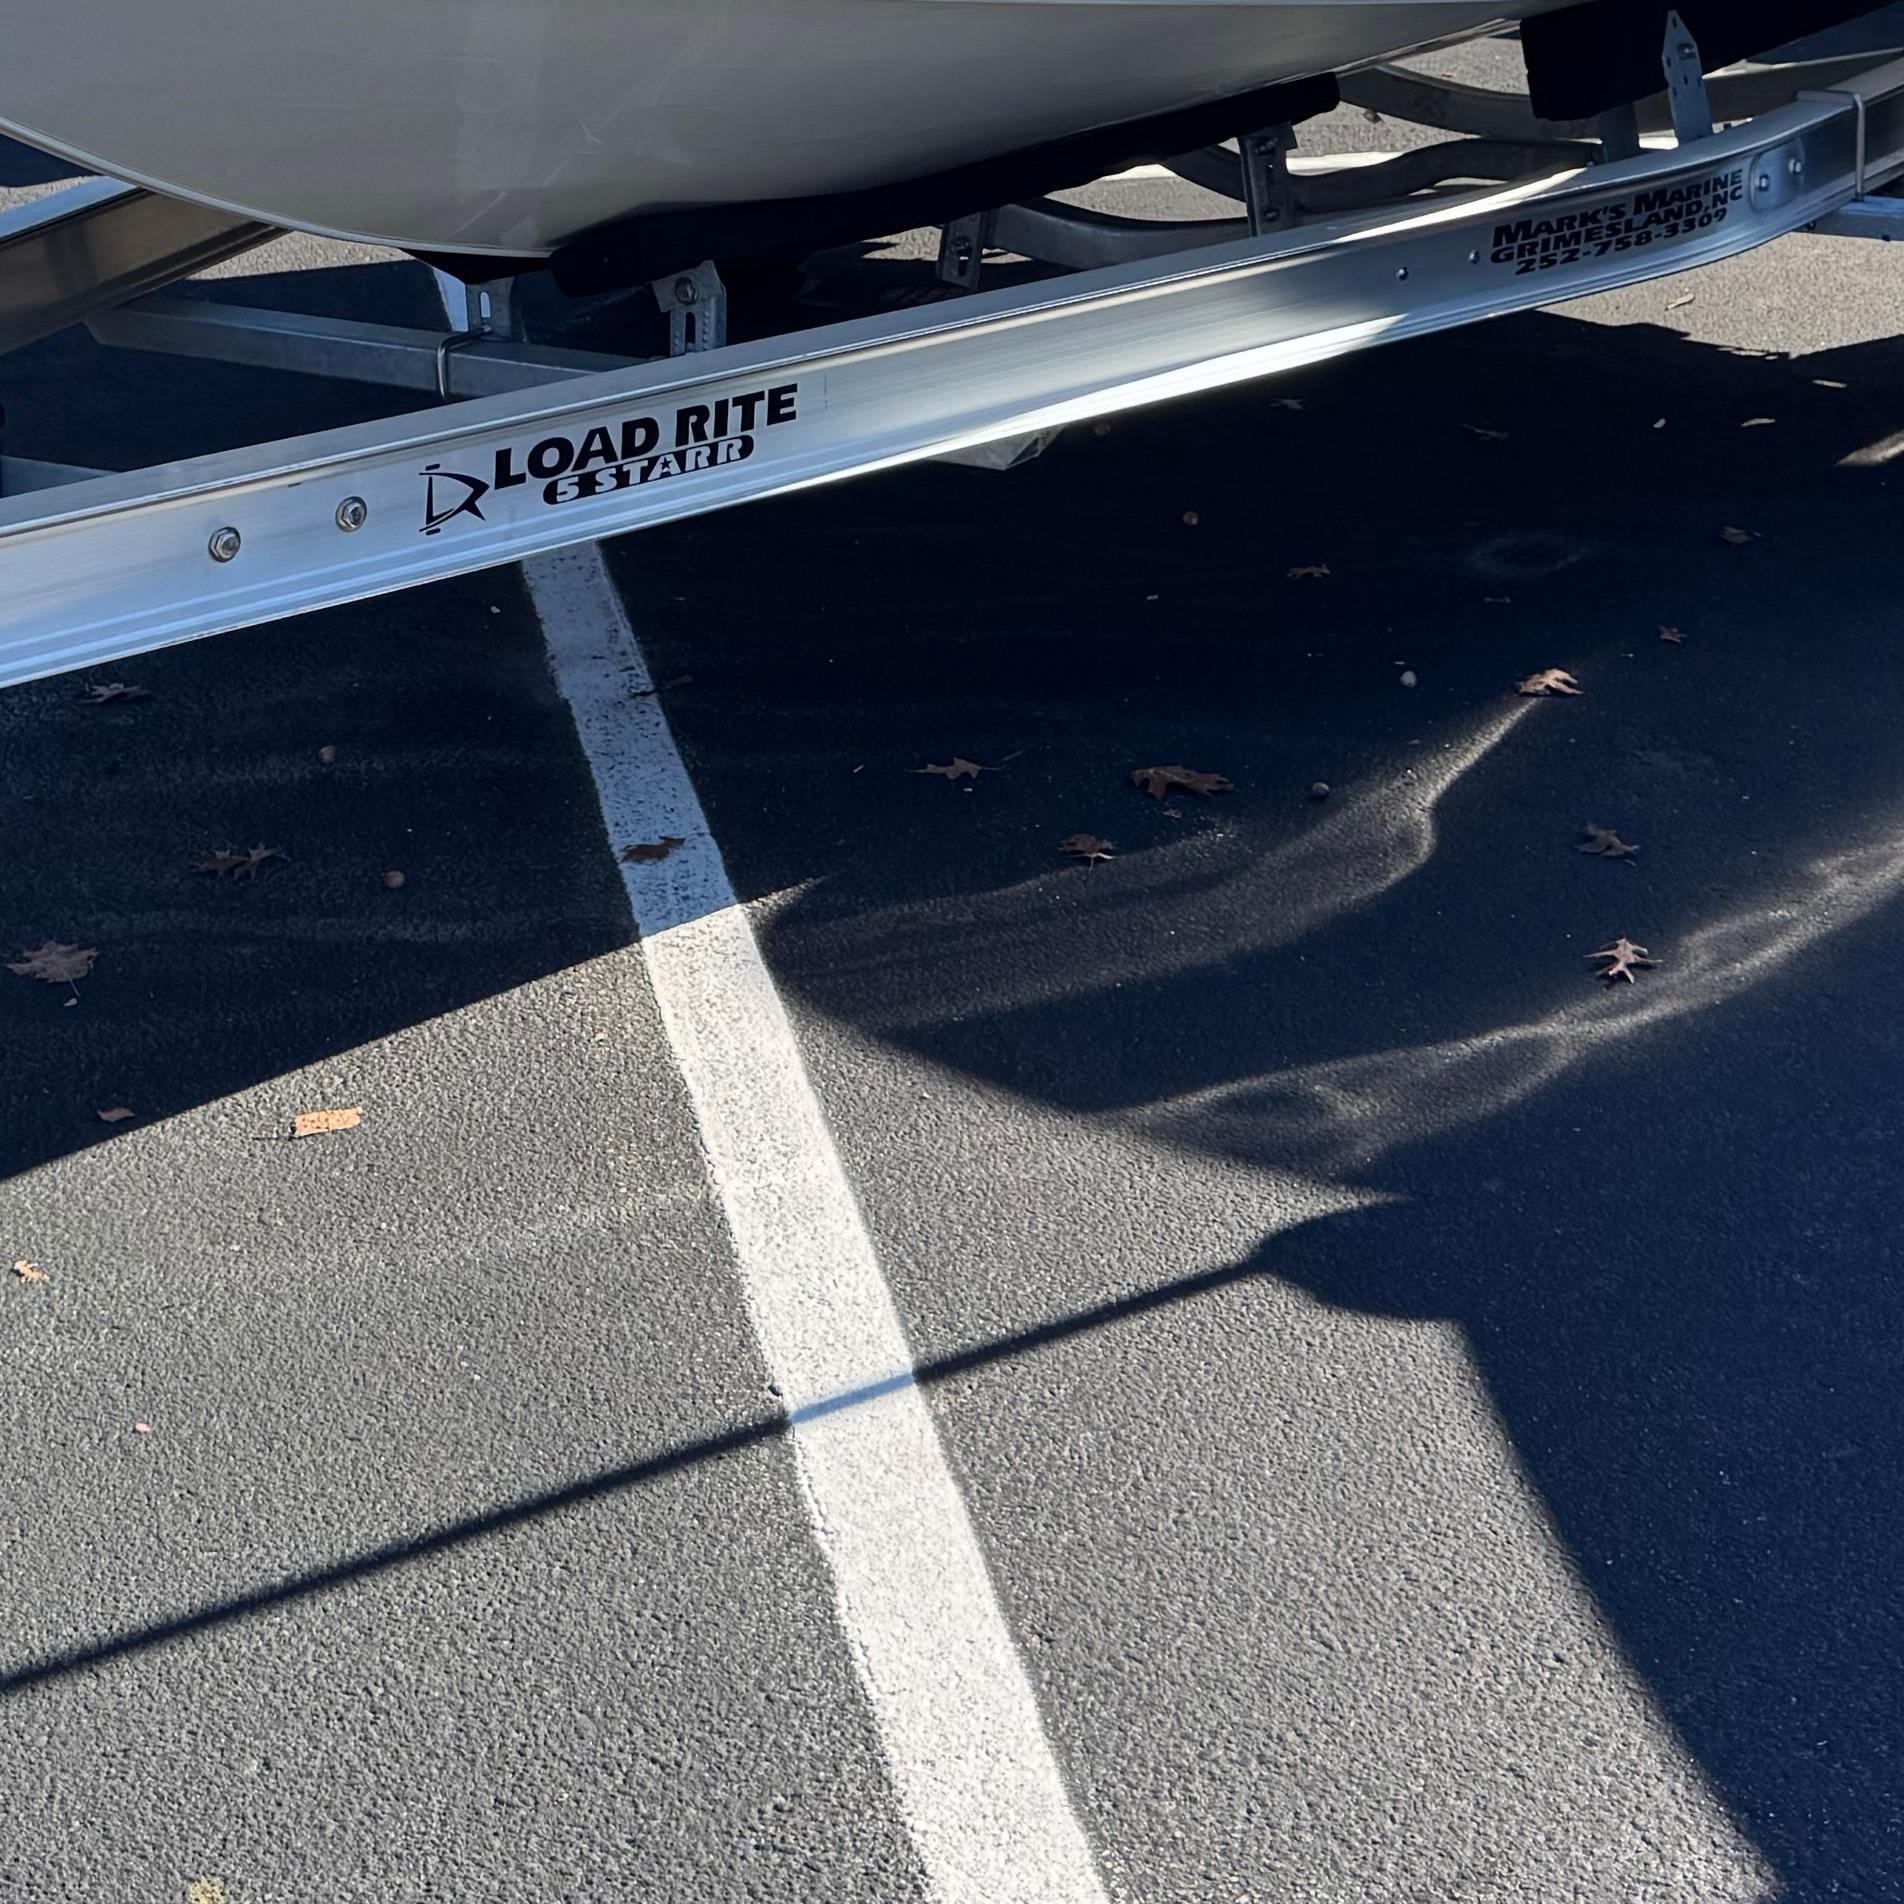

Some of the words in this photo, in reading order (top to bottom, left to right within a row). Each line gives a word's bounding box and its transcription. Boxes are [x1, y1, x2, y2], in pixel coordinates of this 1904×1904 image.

[1492, 202, 1627, 249] MARK'S
[1633, 168, 1744, 216] MARINE
[1514, 207, 1729, 276] 252-758-3309
[494, 416, 660, 490] LOAD
[675, 383, 799, 446] RITE
[555, 476, 581, 504] 5
[594, 437, 745, 495] STARR
